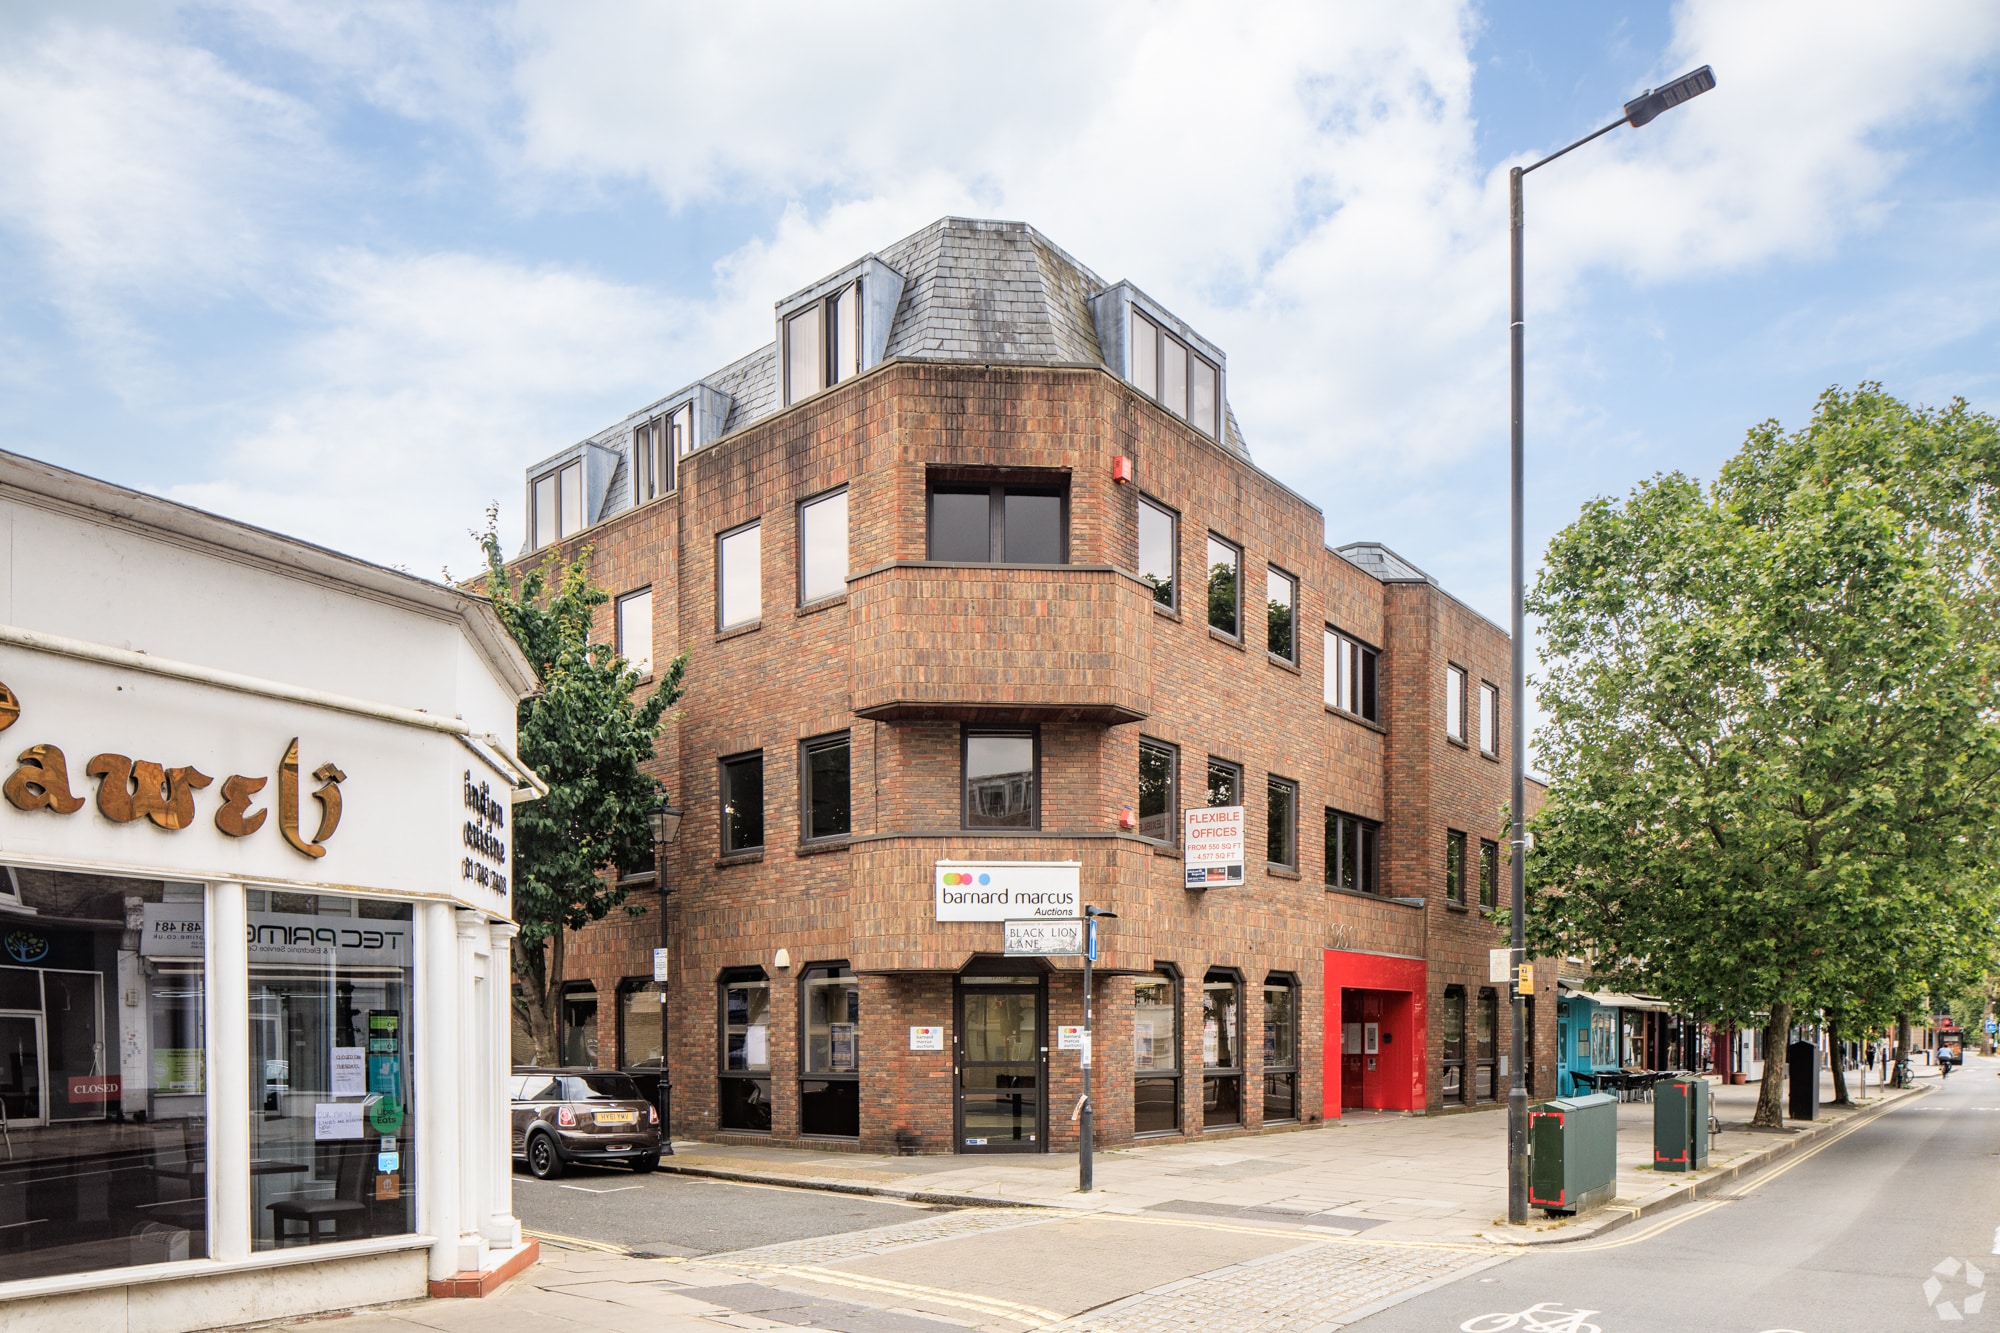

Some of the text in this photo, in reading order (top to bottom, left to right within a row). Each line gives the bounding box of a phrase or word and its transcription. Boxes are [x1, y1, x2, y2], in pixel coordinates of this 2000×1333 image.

[1189, 811, 1240, 824] FLEXIBLE
[1191, 826, 1237, 839] OFFICES
[1187, 843, 1207, 851] FROM
[1221, 842, 1232, 850] SQ
[1215, 852, 1226, 860] SQ
[1226, 851, 1236, 859] FT
[943, 888, 1074, 904] barnard marcus
[1034, 907, 1073, 916] Auctions
[1010, 927, 1078, 937] BLACK LION
[1009, 939, 1039, 949] LANE
[73, 1083, 119, 1095] CLOSED
[377, 1108, 396, 1116] Uber
[377, 1116, 397, 1124] Eats
